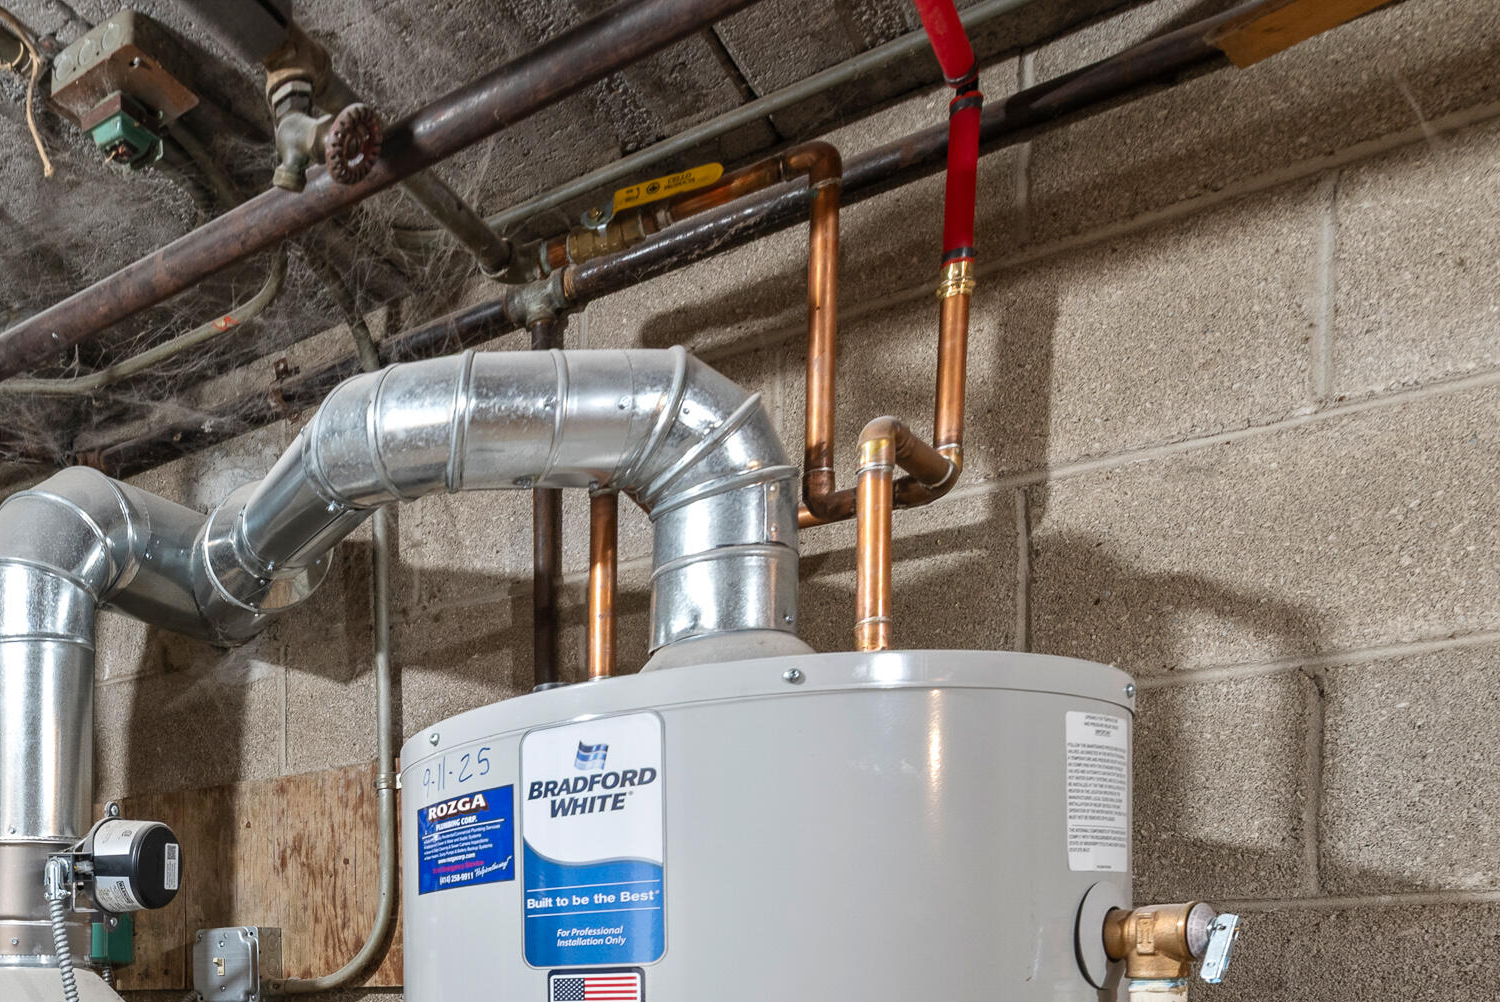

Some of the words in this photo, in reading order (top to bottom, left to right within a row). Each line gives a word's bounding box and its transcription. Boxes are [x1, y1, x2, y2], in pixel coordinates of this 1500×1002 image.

[528, 768, 656, 800] BRADFORD
[428, 794, 486, 820] ROZGA
[550, 792, 626, 818] WHITE
[461, 815, 478, 825] CORP.
[527, 898, 553, 909] Built
[556, 897, 568, 907] to
[572, 895, 589, 906] be
[594, 893, 615, 903] the
[620, 890, 654, 902] Best
[557, 928, 570, 937] For
[571, 926, 623, 936] Professional
[557, 938, 604, 947] Installation
[605, 936, 626, 946] Only
